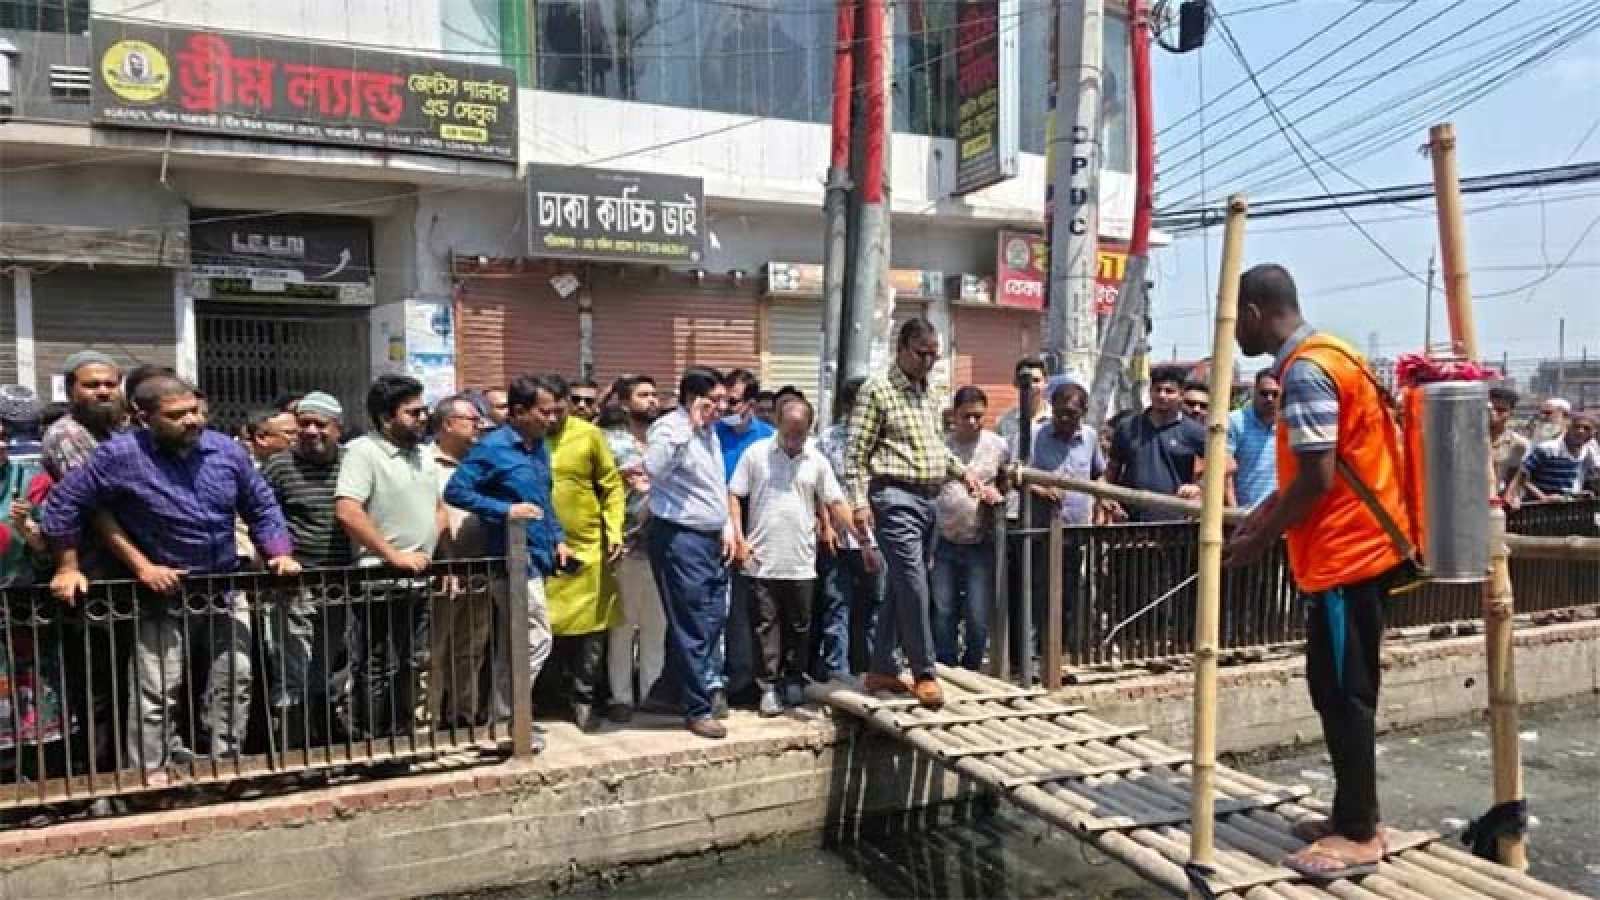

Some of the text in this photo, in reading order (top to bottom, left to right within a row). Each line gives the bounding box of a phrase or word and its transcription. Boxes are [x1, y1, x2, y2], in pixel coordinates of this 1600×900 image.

[175, 31, 275, 112] ড্রীম
[283, 63, 405, 124] ল্যান্ড
[453, 101, 497, 126] সেলুন
[537, 184, 698, 236] ঢাকা কাচ্চি ভাই
